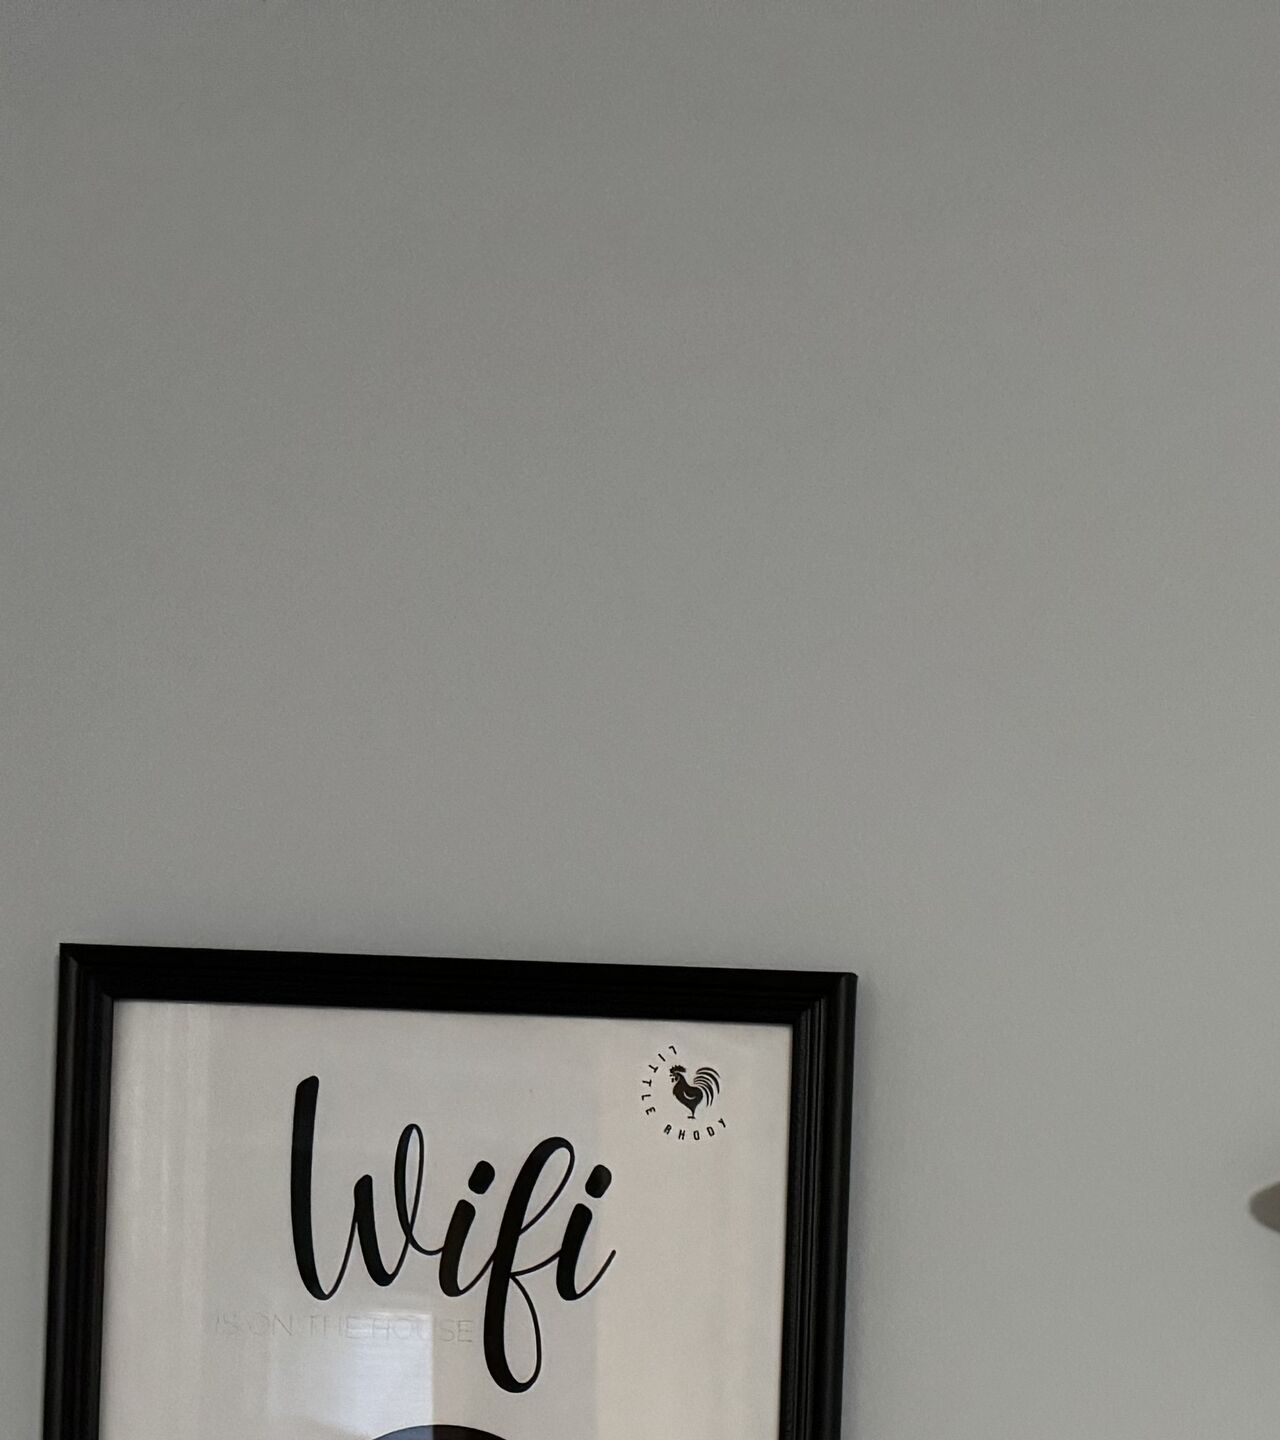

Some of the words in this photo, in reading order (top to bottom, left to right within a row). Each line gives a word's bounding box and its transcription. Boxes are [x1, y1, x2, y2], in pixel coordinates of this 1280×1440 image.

[641, 1045, 677, 1115] LITTLE
[664, 1118, 726, 1141] RHODY
[289, 1075, 617, 1394] Wifi
